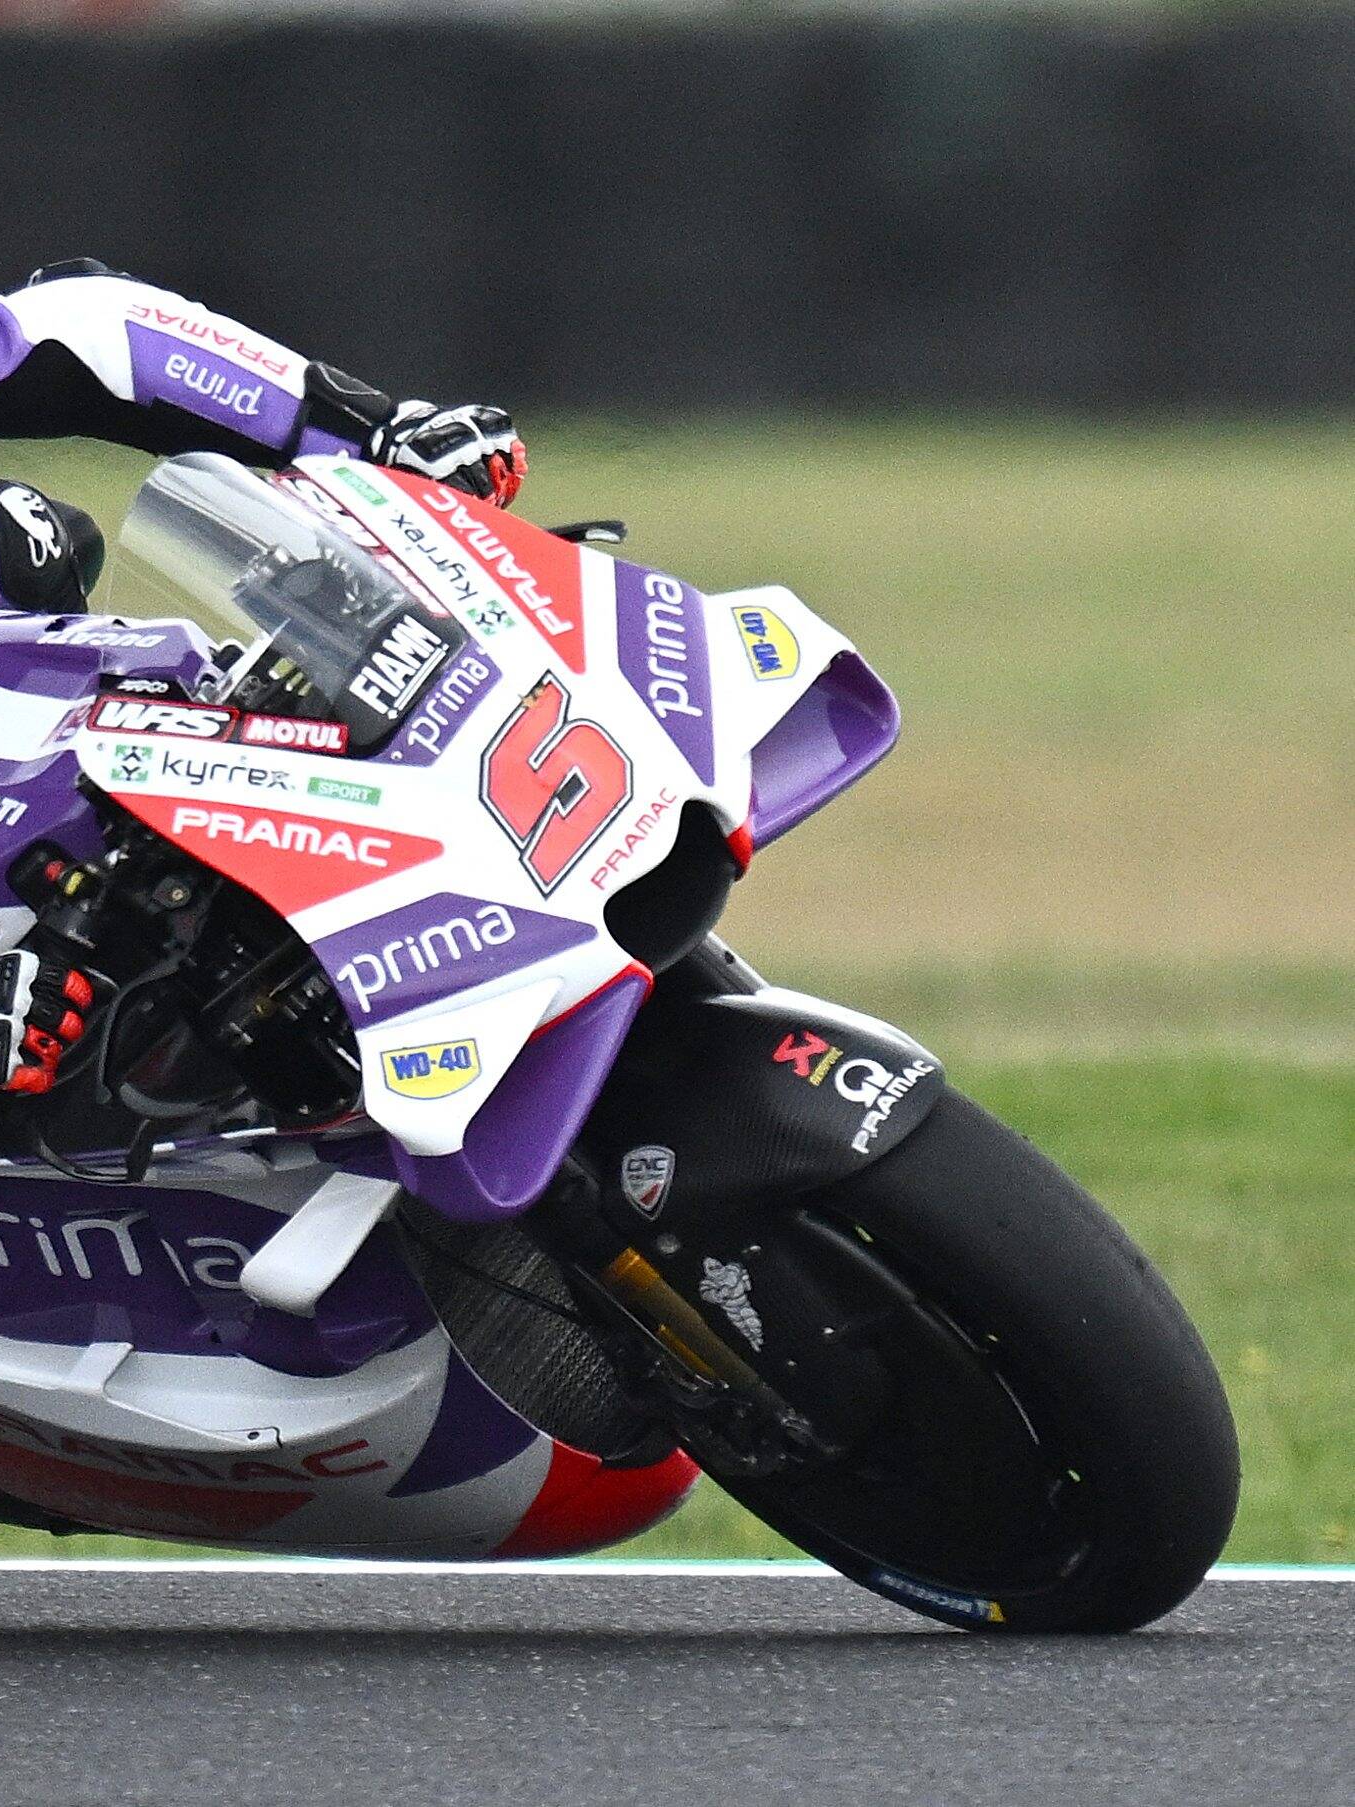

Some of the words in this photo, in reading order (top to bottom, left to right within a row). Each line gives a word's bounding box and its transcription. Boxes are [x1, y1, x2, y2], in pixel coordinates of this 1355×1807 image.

[131, 303, 291, 378] PRAMAC
[164, 353, 264, 417] prima
[423, 488, 574, 636] PRAMAC
[348, 613, 444, 717] FIAMM
[644, 572, 704, 719] prima
[96, 701, 231, 738] WRS
[245, 717, 344, 750] MOTUL
[406, 654, 492, 757] prima
[317, 781, 374, 802] SPORT
[479, 668, 634, 900] 5
[171, 807, 393, 869] PRAMAC
[591, 785, 680, 891] PRAMAC
[336, 904, 518, 1014] prima
[389, 1044, 474, 1082] WD-40
[850, 1059, 936, 1154] PRAMAC
